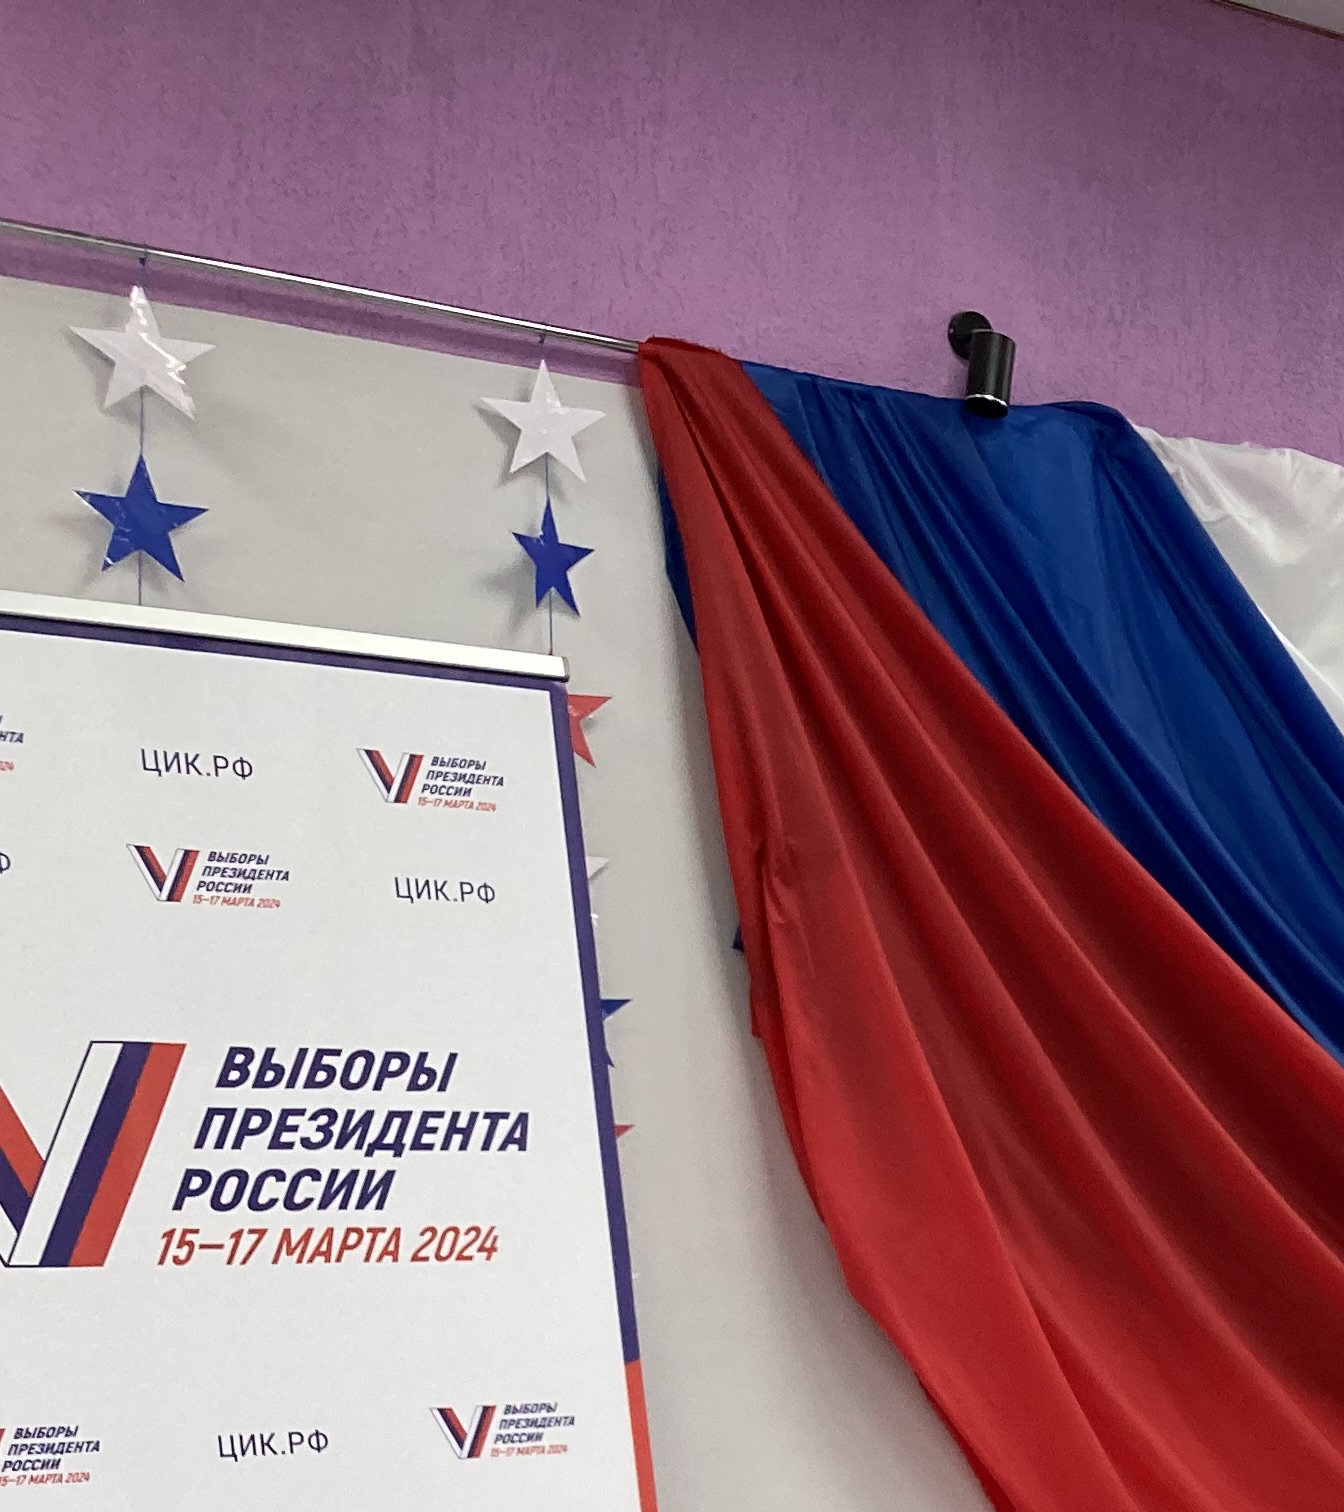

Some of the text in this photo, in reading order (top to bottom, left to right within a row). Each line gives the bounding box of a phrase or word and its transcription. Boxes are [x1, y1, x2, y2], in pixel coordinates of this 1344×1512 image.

[141, 748, 252, 780] ЦИК.РФ
[431, 756, 486, 770] ВЫБОРЫ
[426, 770, 503, 786] ПРЕЗИДЕНТА
[421, 784, 472, 797] РОССИИ
[207, 851, 269, 865] ВЫБОРЫ
[202, 866, 289, 881] ПРЕЗИДЕНТА
[196, 881, 253, 894] РОССИИ
[394, 877, 496, 904] ЦИК.РФ
[215, 1046, 458, 1092] ВЫБОРЫ
[193, 1107, 529, 1158] ПРЕЗИДЕНТА
[172, 1168, 396, 1212] РОССИИ
[271, 1227, 401, 1265] МАРТА
[409, 1225, 498, 1262] 2024
[13, 1426, 79, 1439] ВЫБОРЫ
[8, 1440, 100, 1456] ПРЕЗИДЕНТА
[218, 1429, 328, 1462] ЦИК.РФ
[1, 1458, 61, 1472] РОССИИ
